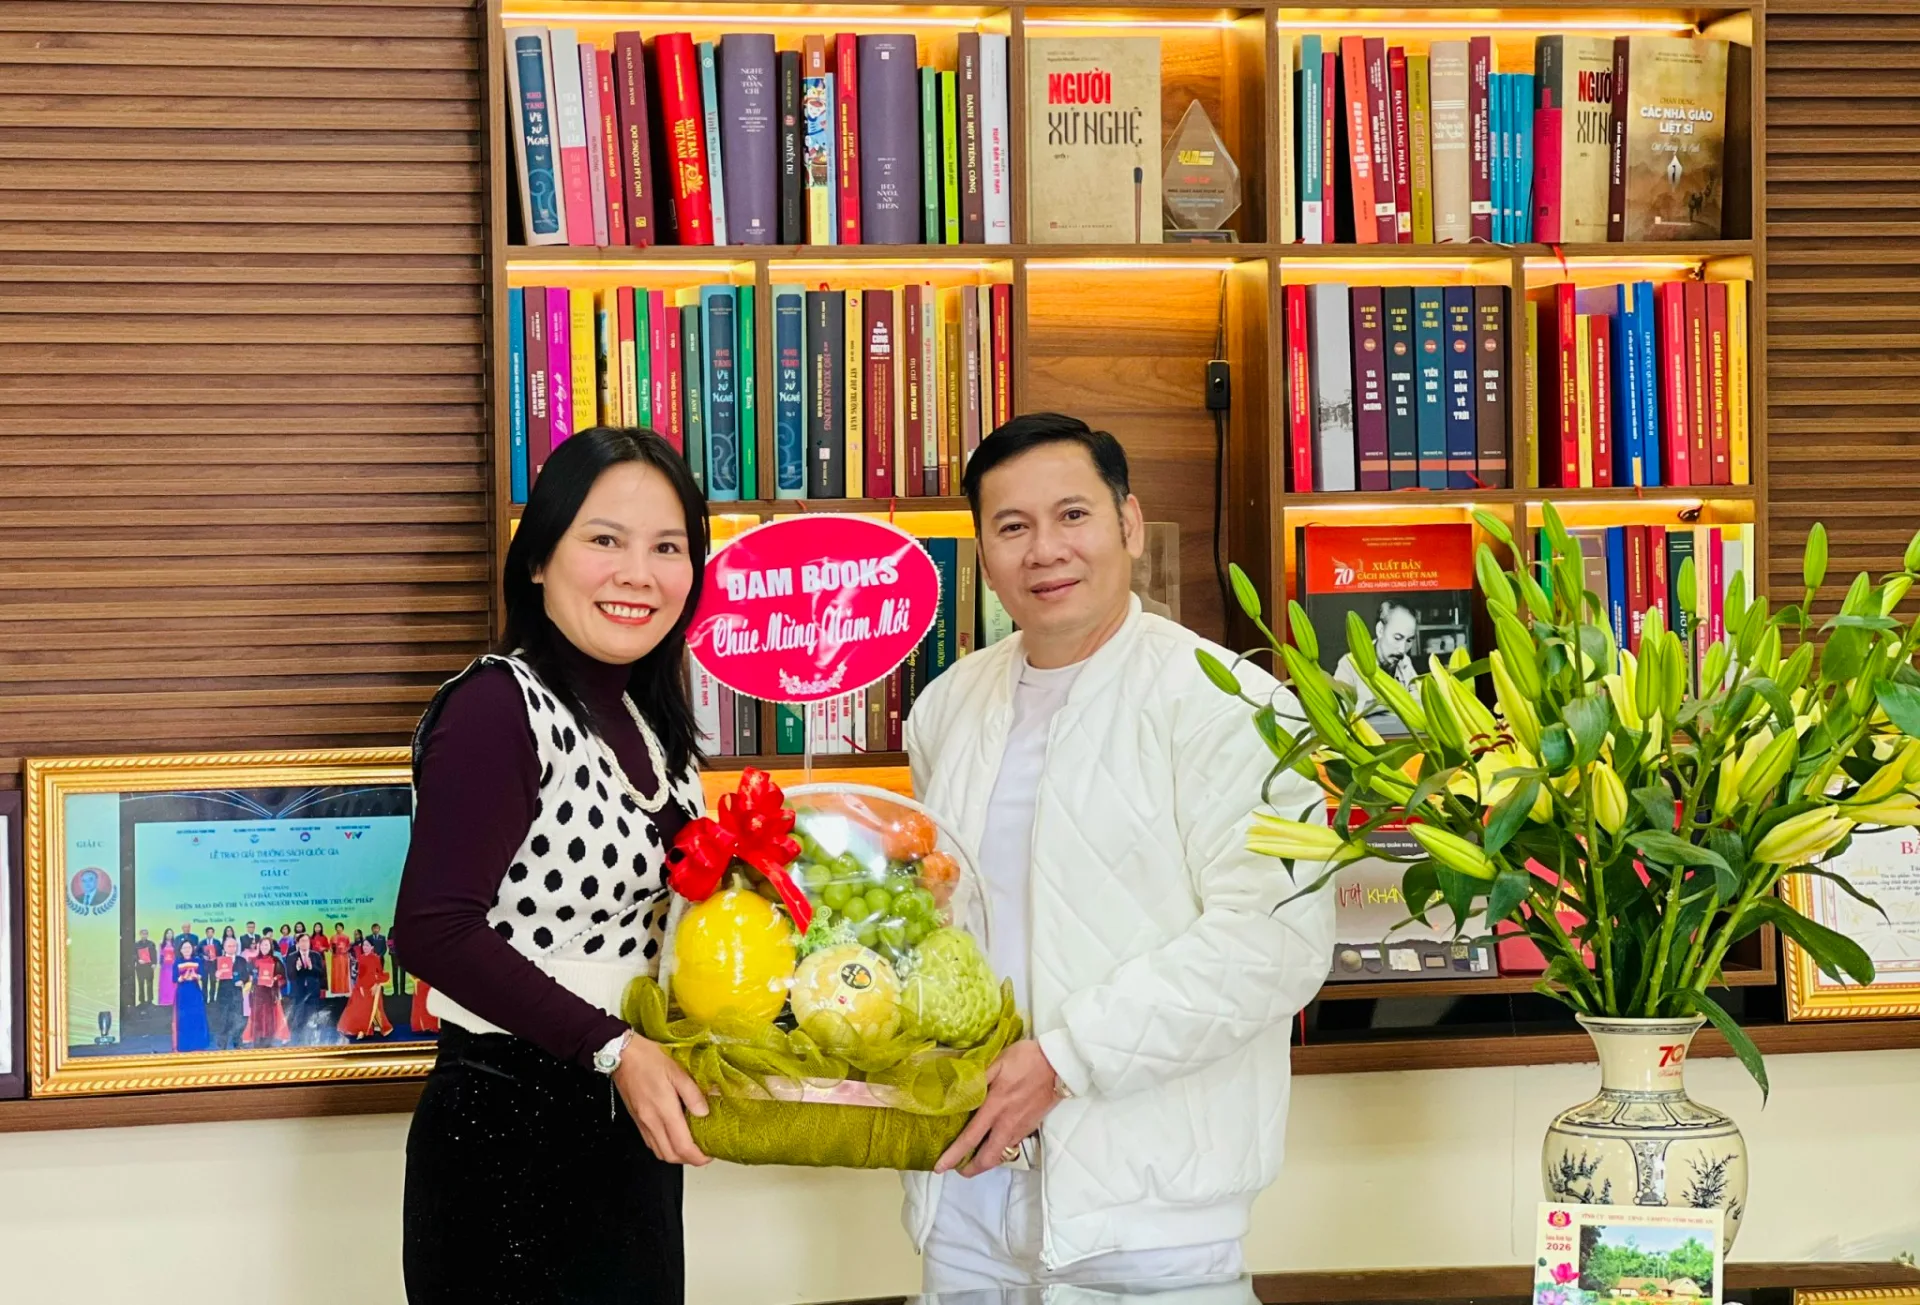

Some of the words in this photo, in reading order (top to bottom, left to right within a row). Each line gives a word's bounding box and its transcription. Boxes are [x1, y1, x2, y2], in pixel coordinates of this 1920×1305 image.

[1048, 67, 1111, 104] NGƯỜI
[1579, 67, 1612, 103] NGƯỜ
[1640, 104, 1662, 118] CÁC
[1663, 105, 1686, 119] NHÀ
[1688, 107, 1713, 122] GIÁO
[1048, 106, 1080, 145] XỨ
[1084, 106, 1143, 148] NGHỆ
[1397, 123, 1405, 147] LÀNG
[1577, 107, 1597, 144] XỨ
[1660, 120, 1681, 135] LIỆT
[1372, 559, 1399, 571] XUẤT
[1401, 558, 1421, 570] BẢN
[727, 567, 794, 602] ĐAM
[801, 556, 900, 594] BOOKS
[1334, 568, 1355, 586] 70
[713, 617, 760, 658] Chúc
[762, 612, 818, 656] Mừng
[822, 605, 872, 649] Năm
[874, 597, 911, 638] Mới
[286, 848, 305, 857] SÁCH
[327, 848, 340, 856] GIA
[260, 868, 281, 877] GIẢI
[283, 869, 290, 877] C
[1659, 1044, 1685, 1067] 70
[1546, 1243, 1572, 1251] 2026
